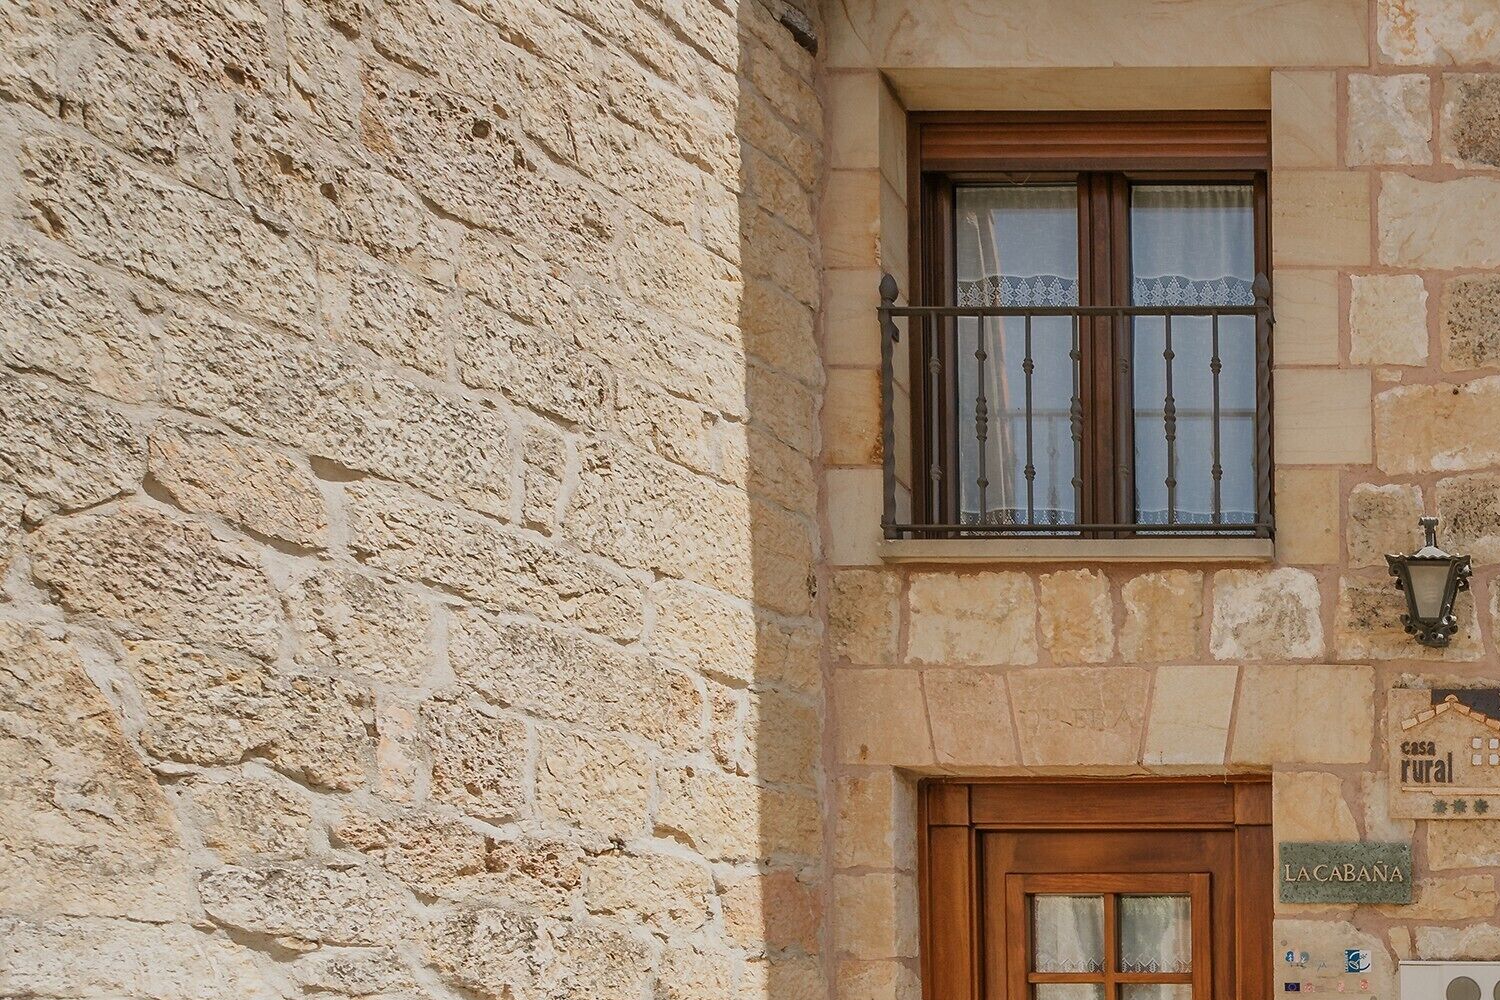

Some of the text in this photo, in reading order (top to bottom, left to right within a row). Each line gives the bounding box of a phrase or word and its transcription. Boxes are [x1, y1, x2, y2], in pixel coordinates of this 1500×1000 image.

[1400, 741, 1436, 756] casa
[1401, 751, 1453, 783] rural
[1284, 860, 1404, 882] LA CABAÑA
